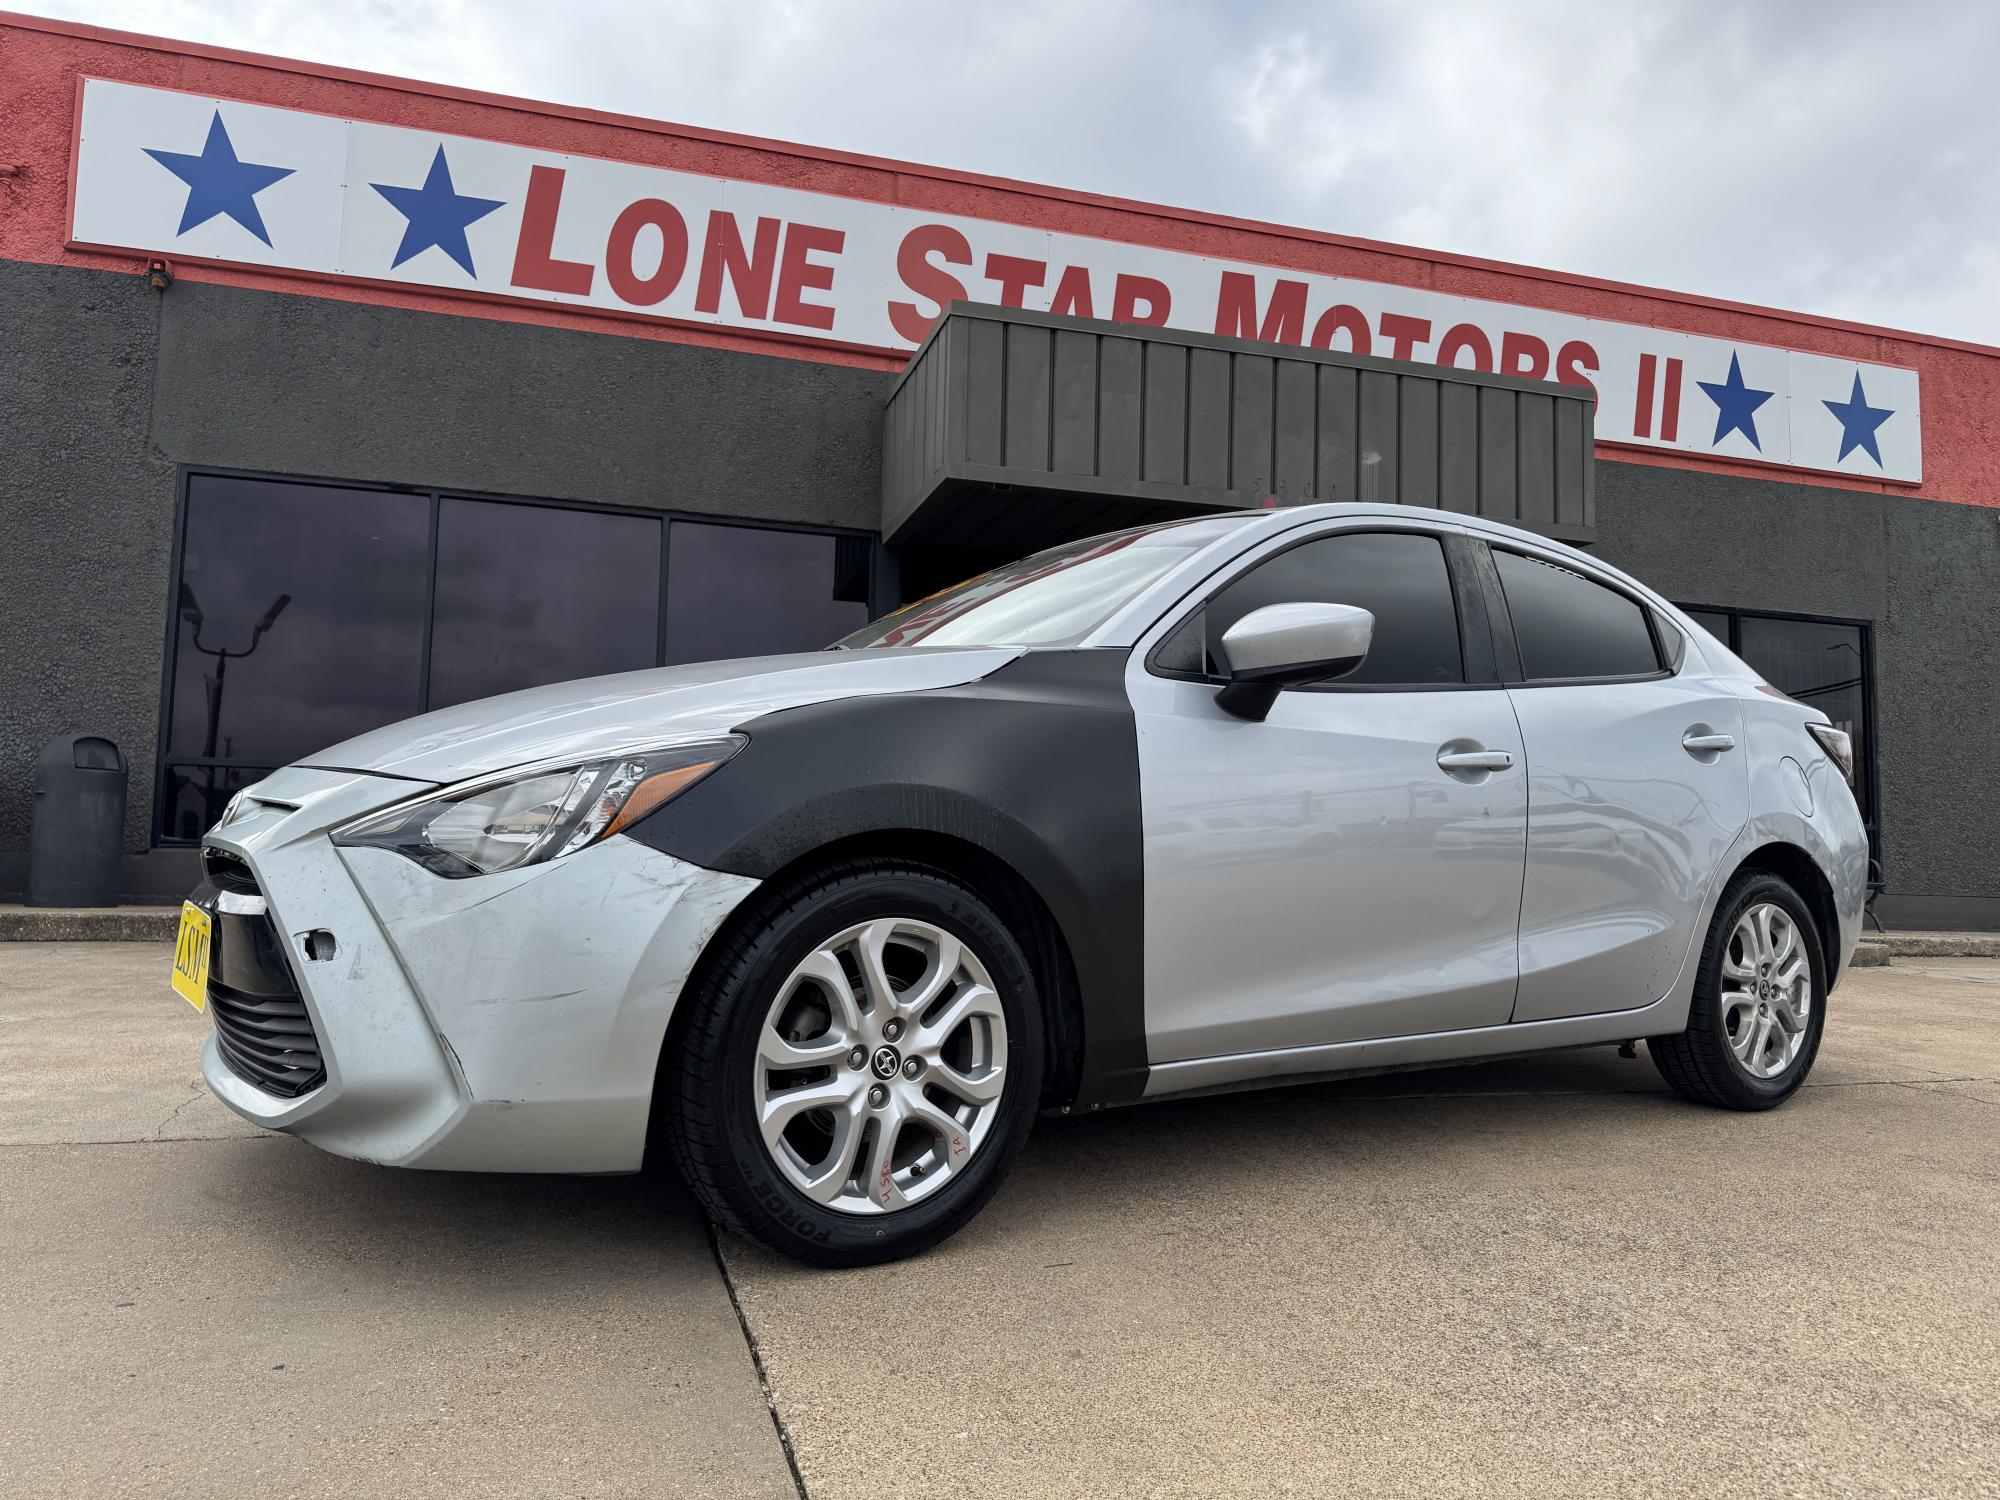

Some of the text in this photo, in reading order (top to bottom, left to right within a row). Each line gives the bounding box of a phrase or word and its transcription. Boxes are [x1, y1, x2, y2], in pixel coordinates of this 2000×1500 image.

[509, 164, 846, 332] LONE
[1633, 352, 1684, 443] II
[750, 1176, 834, 1250] FORCE
